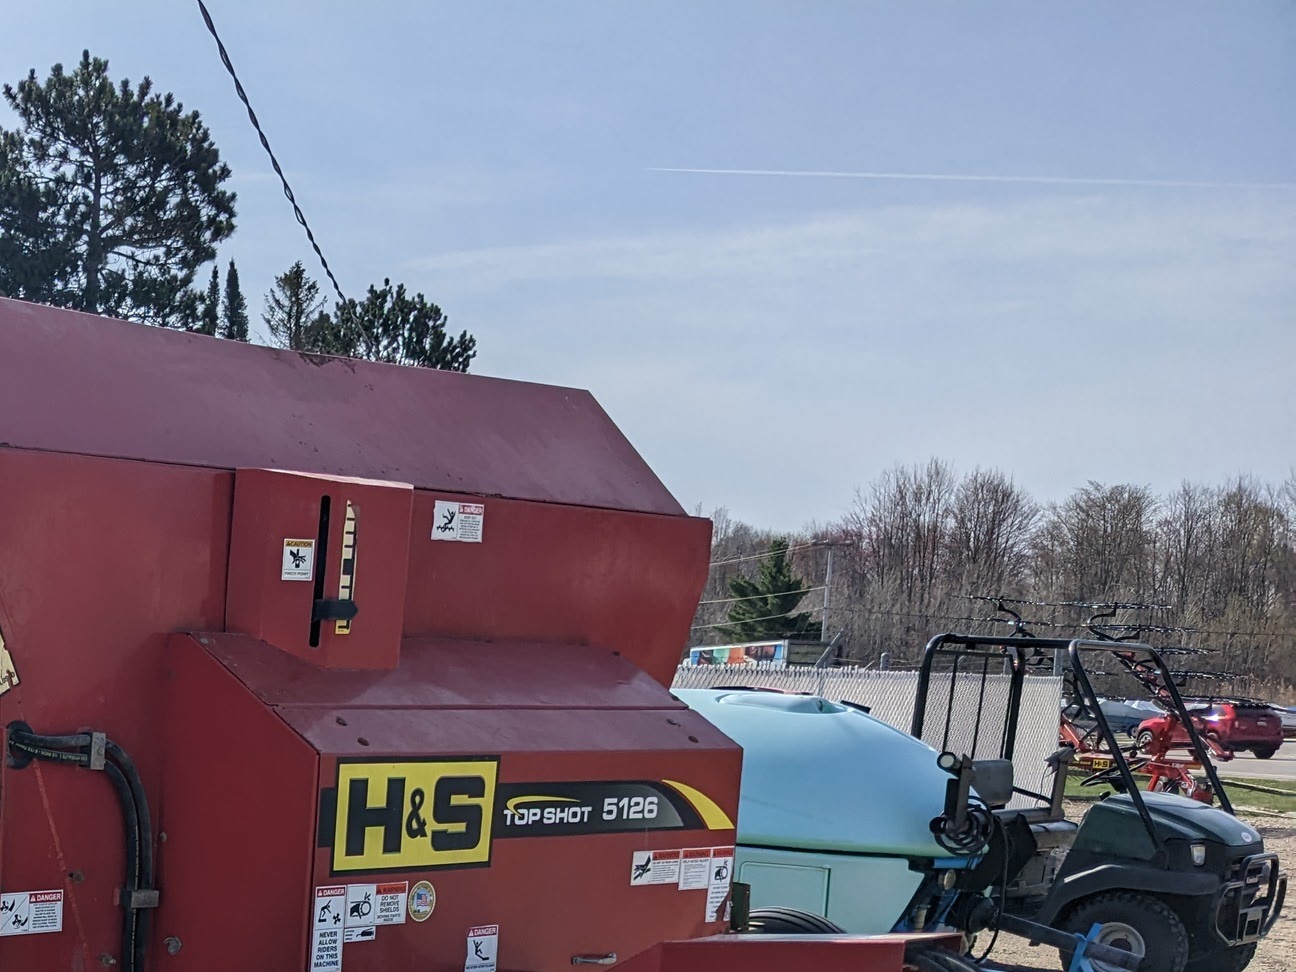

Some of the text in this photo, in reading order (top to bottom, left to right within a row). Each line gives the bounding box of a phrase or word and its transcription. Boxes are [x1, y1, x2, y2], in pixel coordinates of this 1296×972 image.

[504, 796, 658, 826] TOP SHOT 5126
[345, 775, 486, 857] H&S
[324, 888, 344, 896] DANGER
[36, 893, 61, 901] DANGER
[474, 927, 496, 936] DANGER
[313, 960, 339, 968] MACHINE
